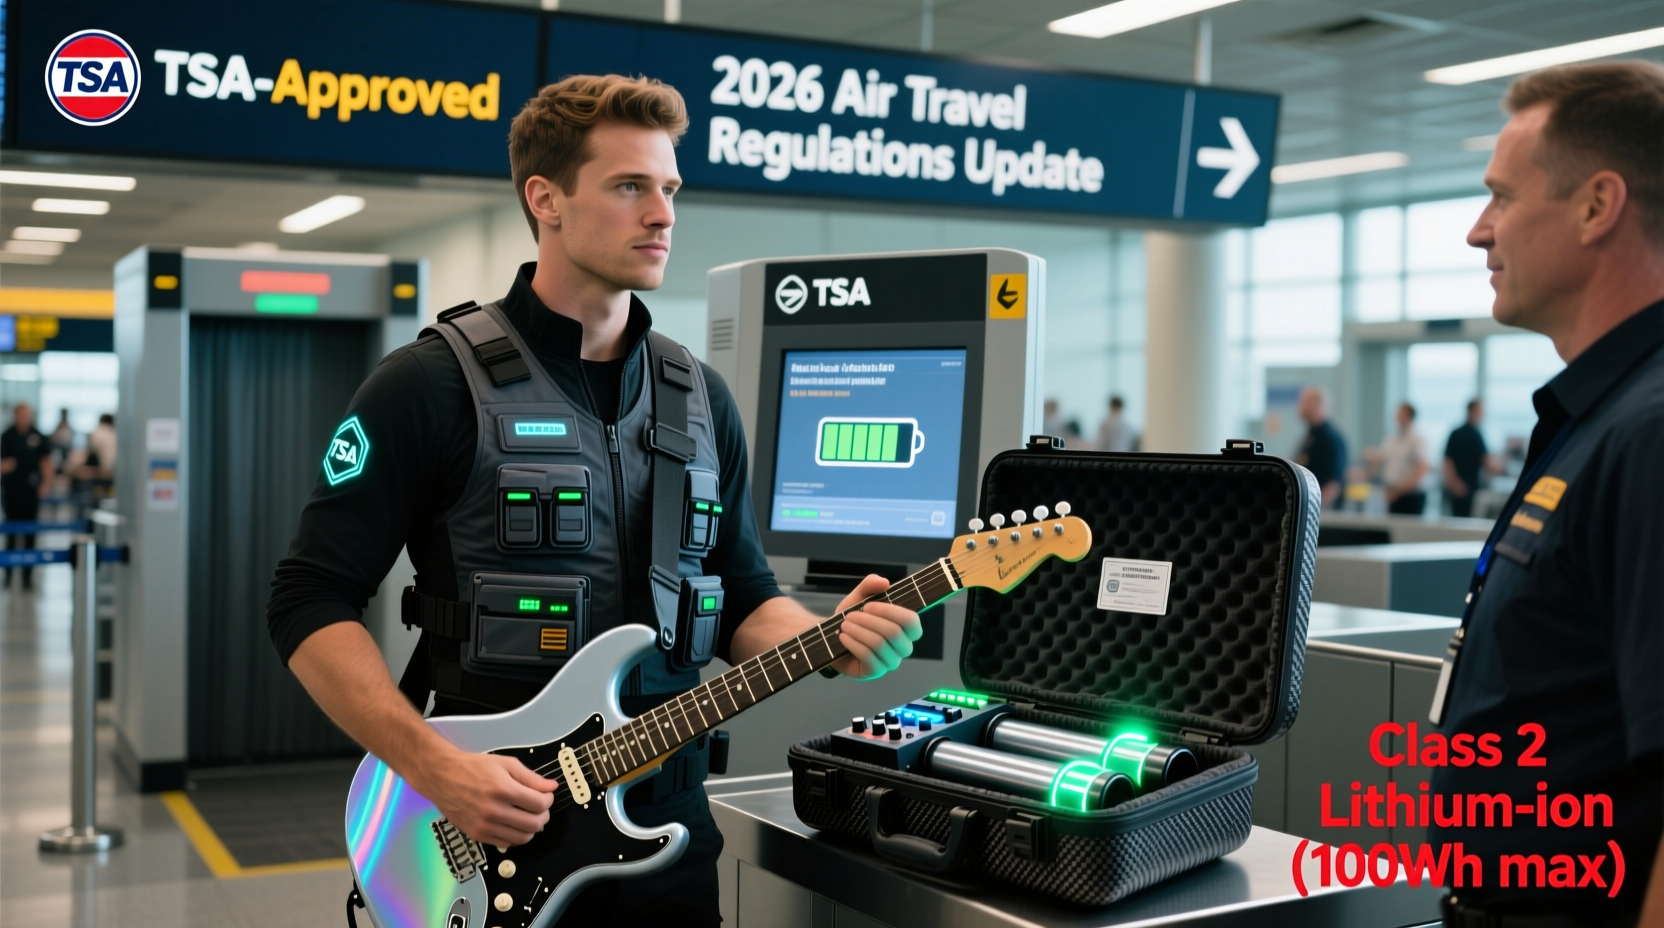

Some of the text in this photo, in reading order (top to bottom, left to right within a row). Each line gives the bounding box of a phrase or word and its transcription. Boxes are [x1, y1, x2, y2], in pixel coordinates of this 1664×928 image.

[154, 49, 500, 122] TSA-Approved
[710, 54, 1028, 132] 2026 Air Travel
[708, 116, 1106, 197] Regulations Update
[812, 276, 871, 307] TSA
[330, 438, 357, 465] TSA
